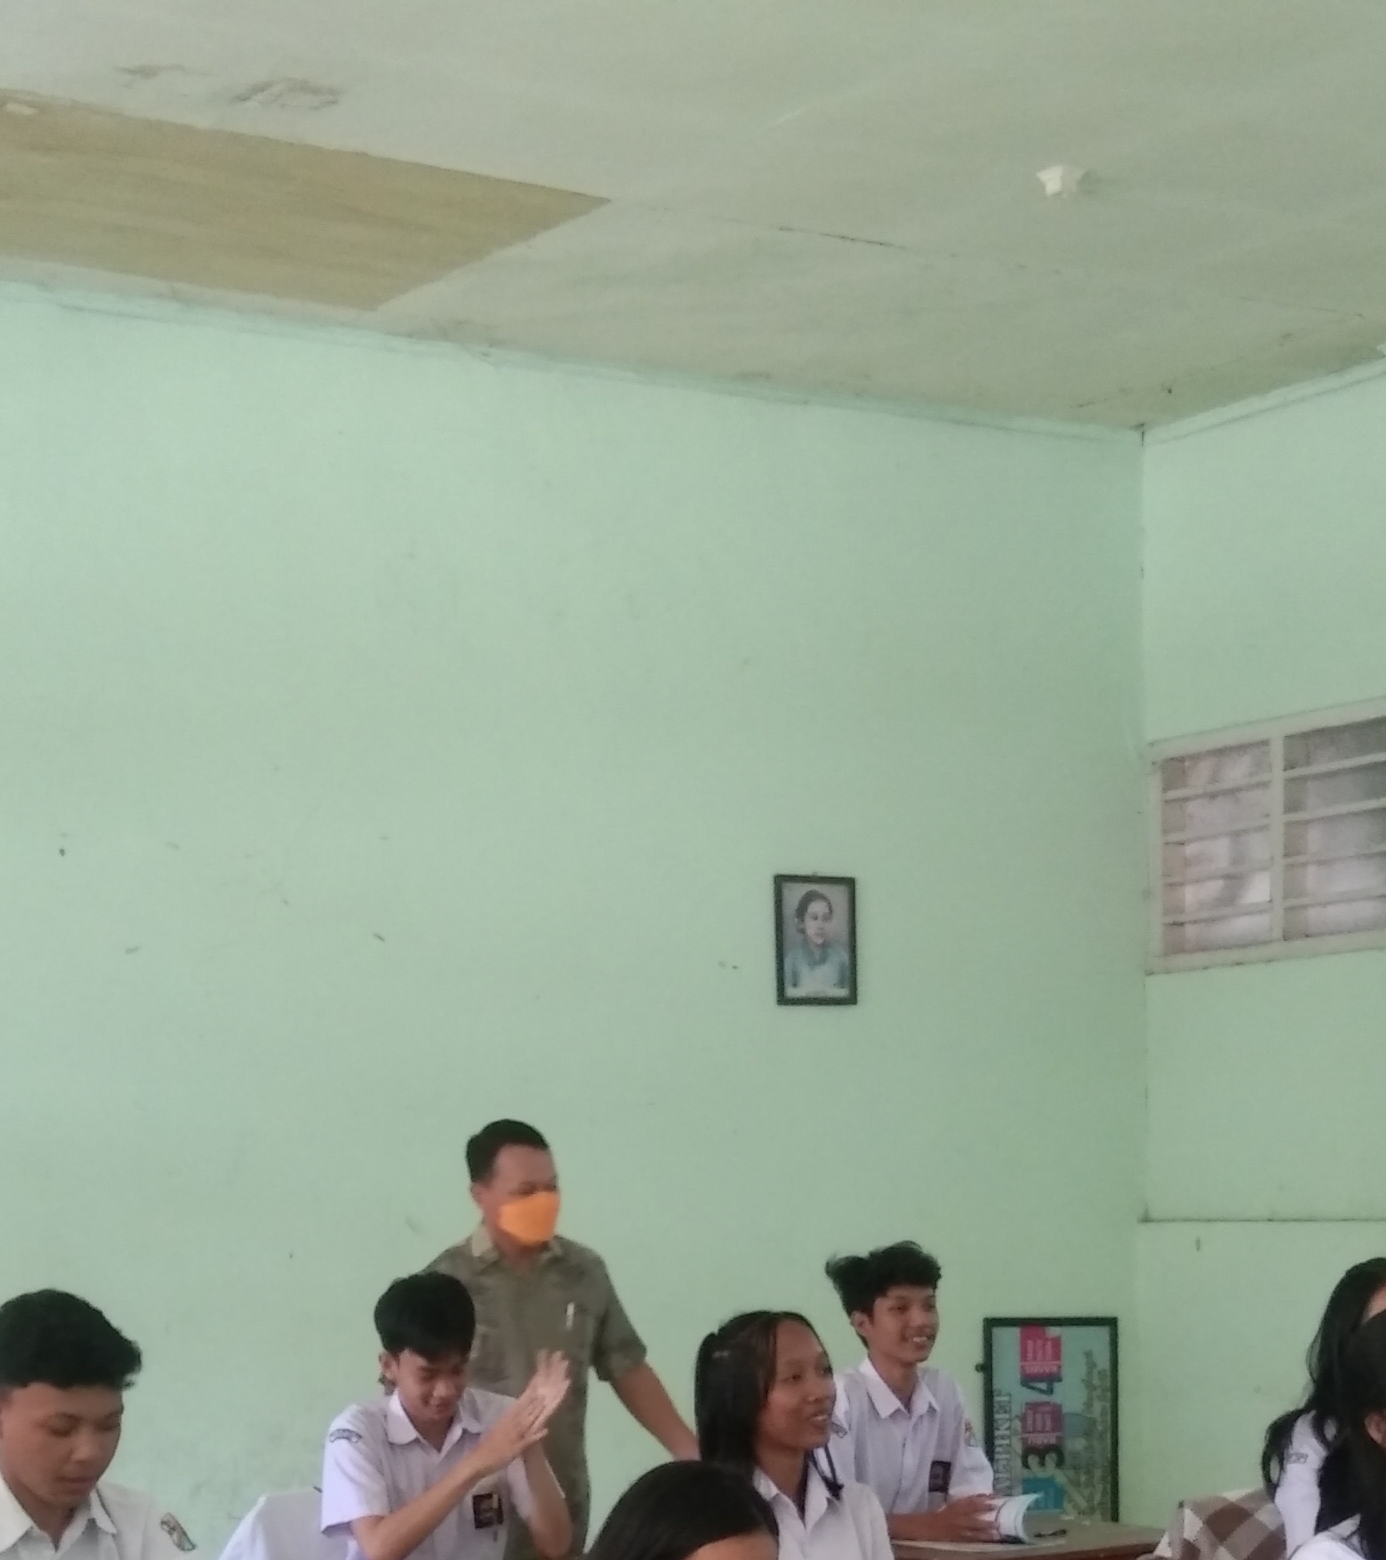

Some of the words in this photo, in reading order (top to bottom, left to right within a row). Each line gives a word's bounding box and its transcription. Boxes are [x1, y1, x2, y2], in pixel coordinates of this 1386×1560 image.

[1020, 1377, 1062, 1395] 4
[993, 1393, 1012, 1461] PIKET
[1022, 1445, 1064, 1471] 3
